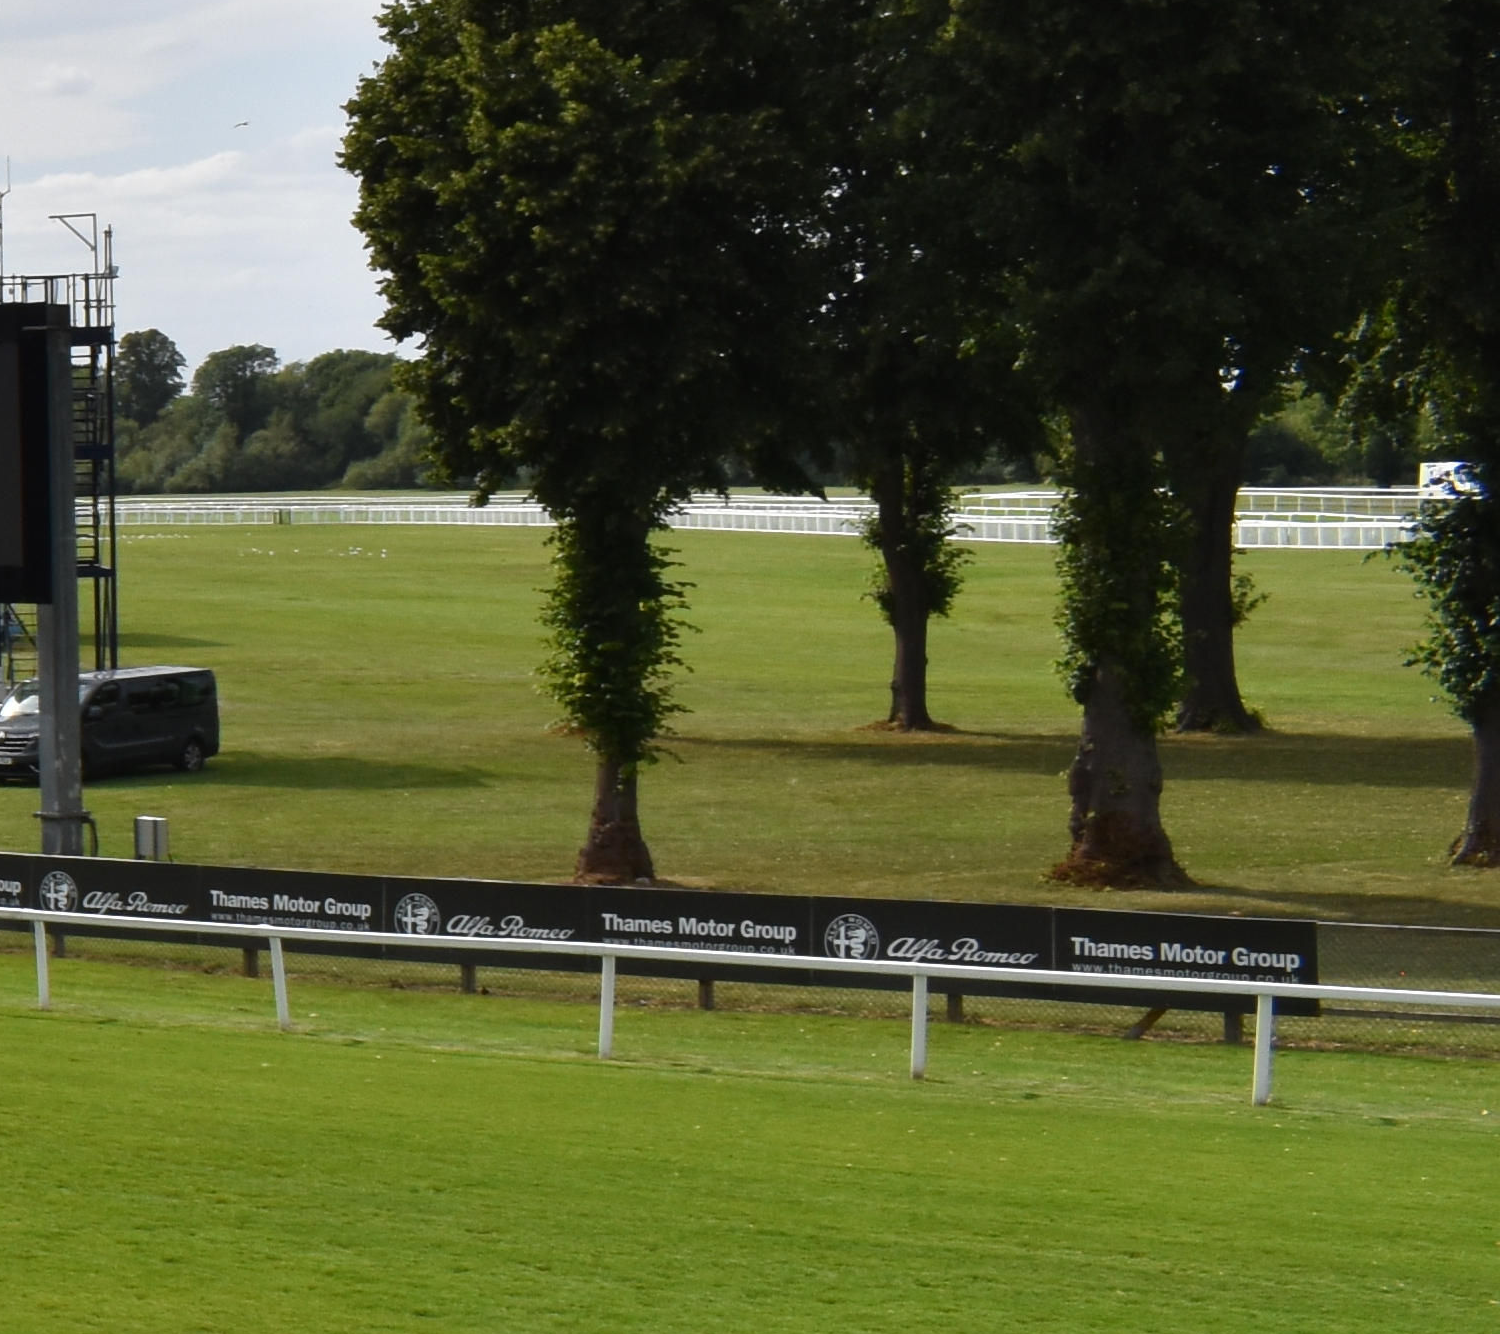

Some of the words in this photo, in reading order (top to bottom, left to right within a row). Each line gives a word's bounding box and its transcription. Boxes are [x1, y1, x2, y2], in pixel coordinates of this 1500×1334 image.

[82, 890, 124, 915] Alfa
[122, 891, 188, 915] Romeo
[210, 889, 270, 910] Thames
[273, 894, 321, 914] Motor
[324, 897, 372, 920] Group
[446, 914, 498, 938] Alfa
[496, 915, 575, 940] Romeo
[601, 913, 673, 934] Thames
[678, 917, 736, 937] Motor
[740, 920, 797, 944] Group
[886, 937, 948, 963] Alfa
[946, 937, 1039, 965] Romeo
[1070, 936, 1153, 960] Thames
[1160, 942, 1227, 965] Motor
[1232, 947, 1300, 972] Group
